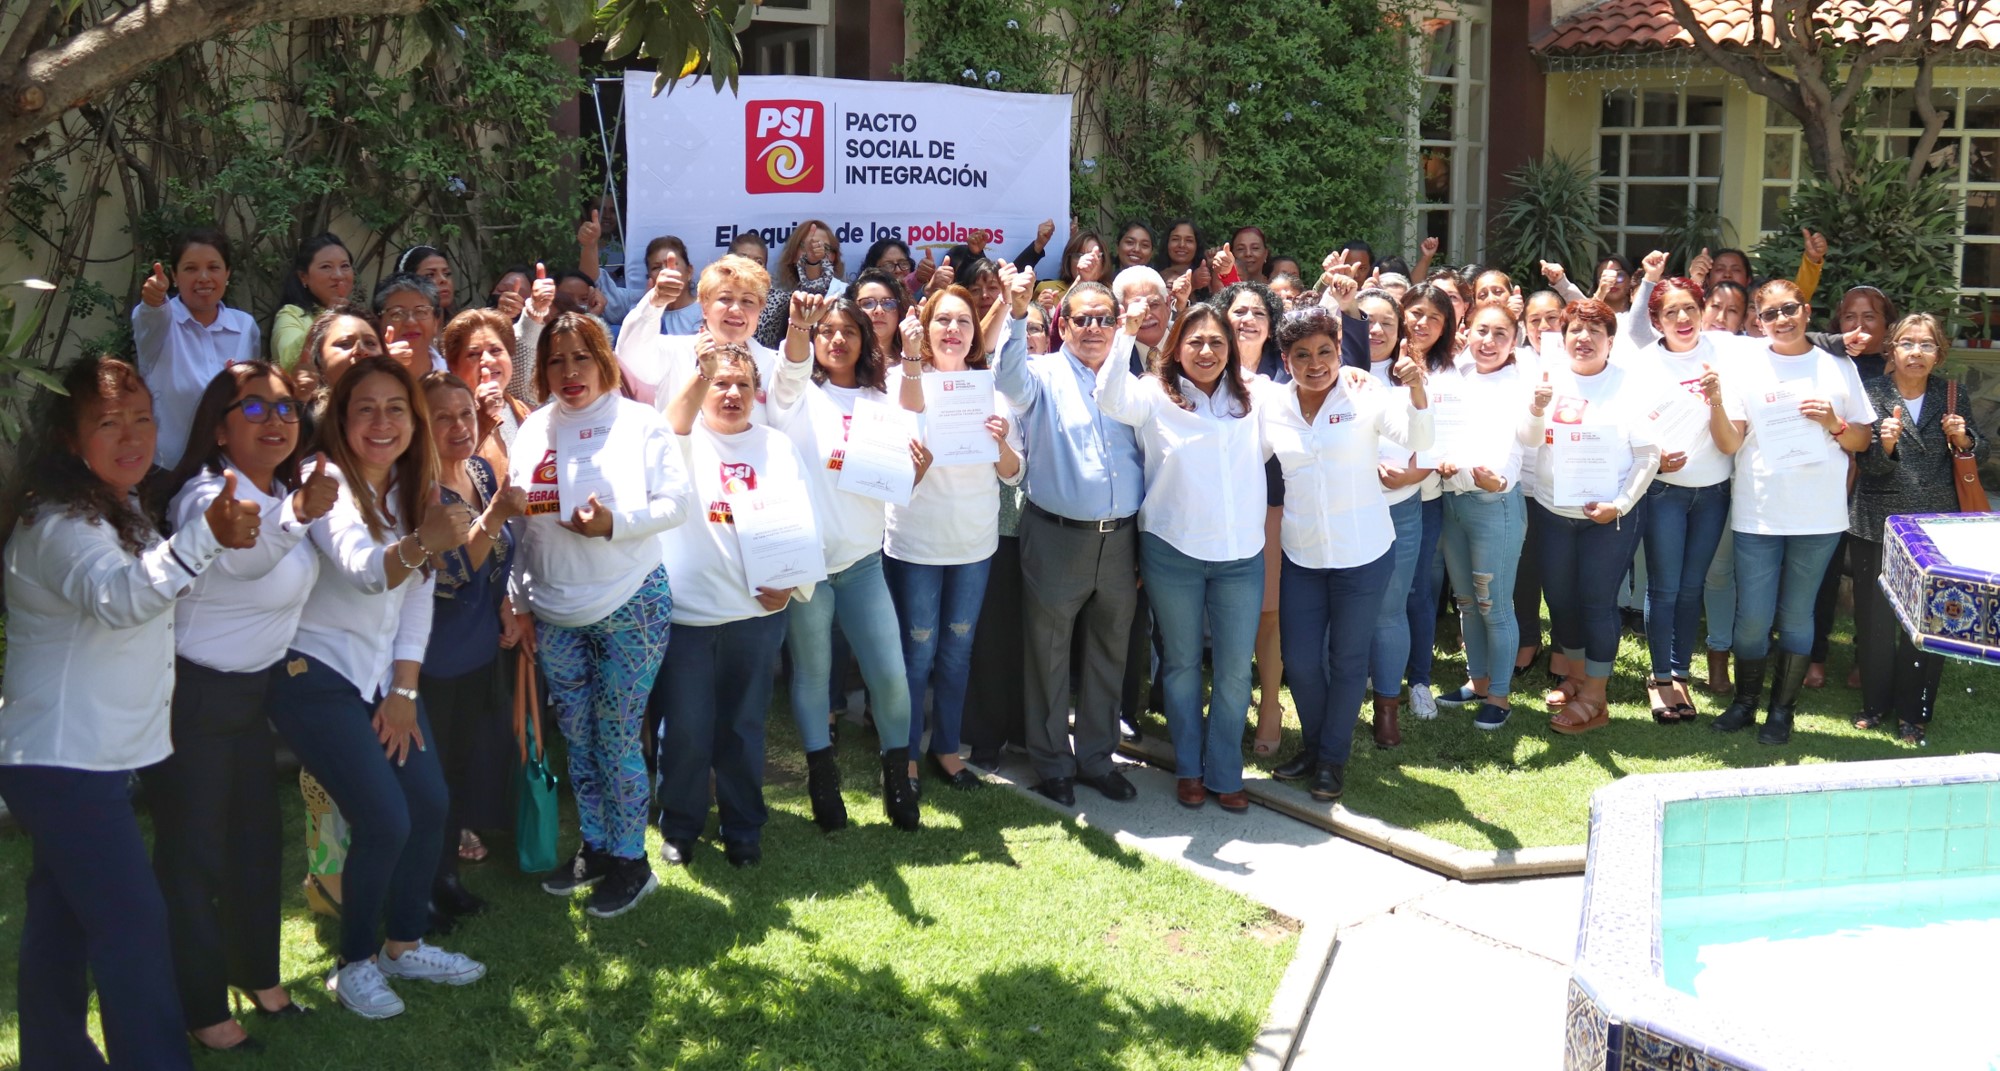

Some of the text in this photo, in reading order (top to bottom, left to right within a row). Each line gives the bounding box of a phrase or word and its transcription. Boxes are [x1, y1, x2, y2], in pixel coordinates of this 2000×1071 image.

[756, 106, 814, 138] PSI
[845, 112, 917, 133] PACTO
[845, 139, 955, 160] SOCIAL DE
[845, 163, 988, 188] INTEGRACIÓN
[715, 224, 738, 247] El
[835, 221, 864, 243] de
[870, 221, 902, 243] los
[724, 465, 751, 479] PSI
